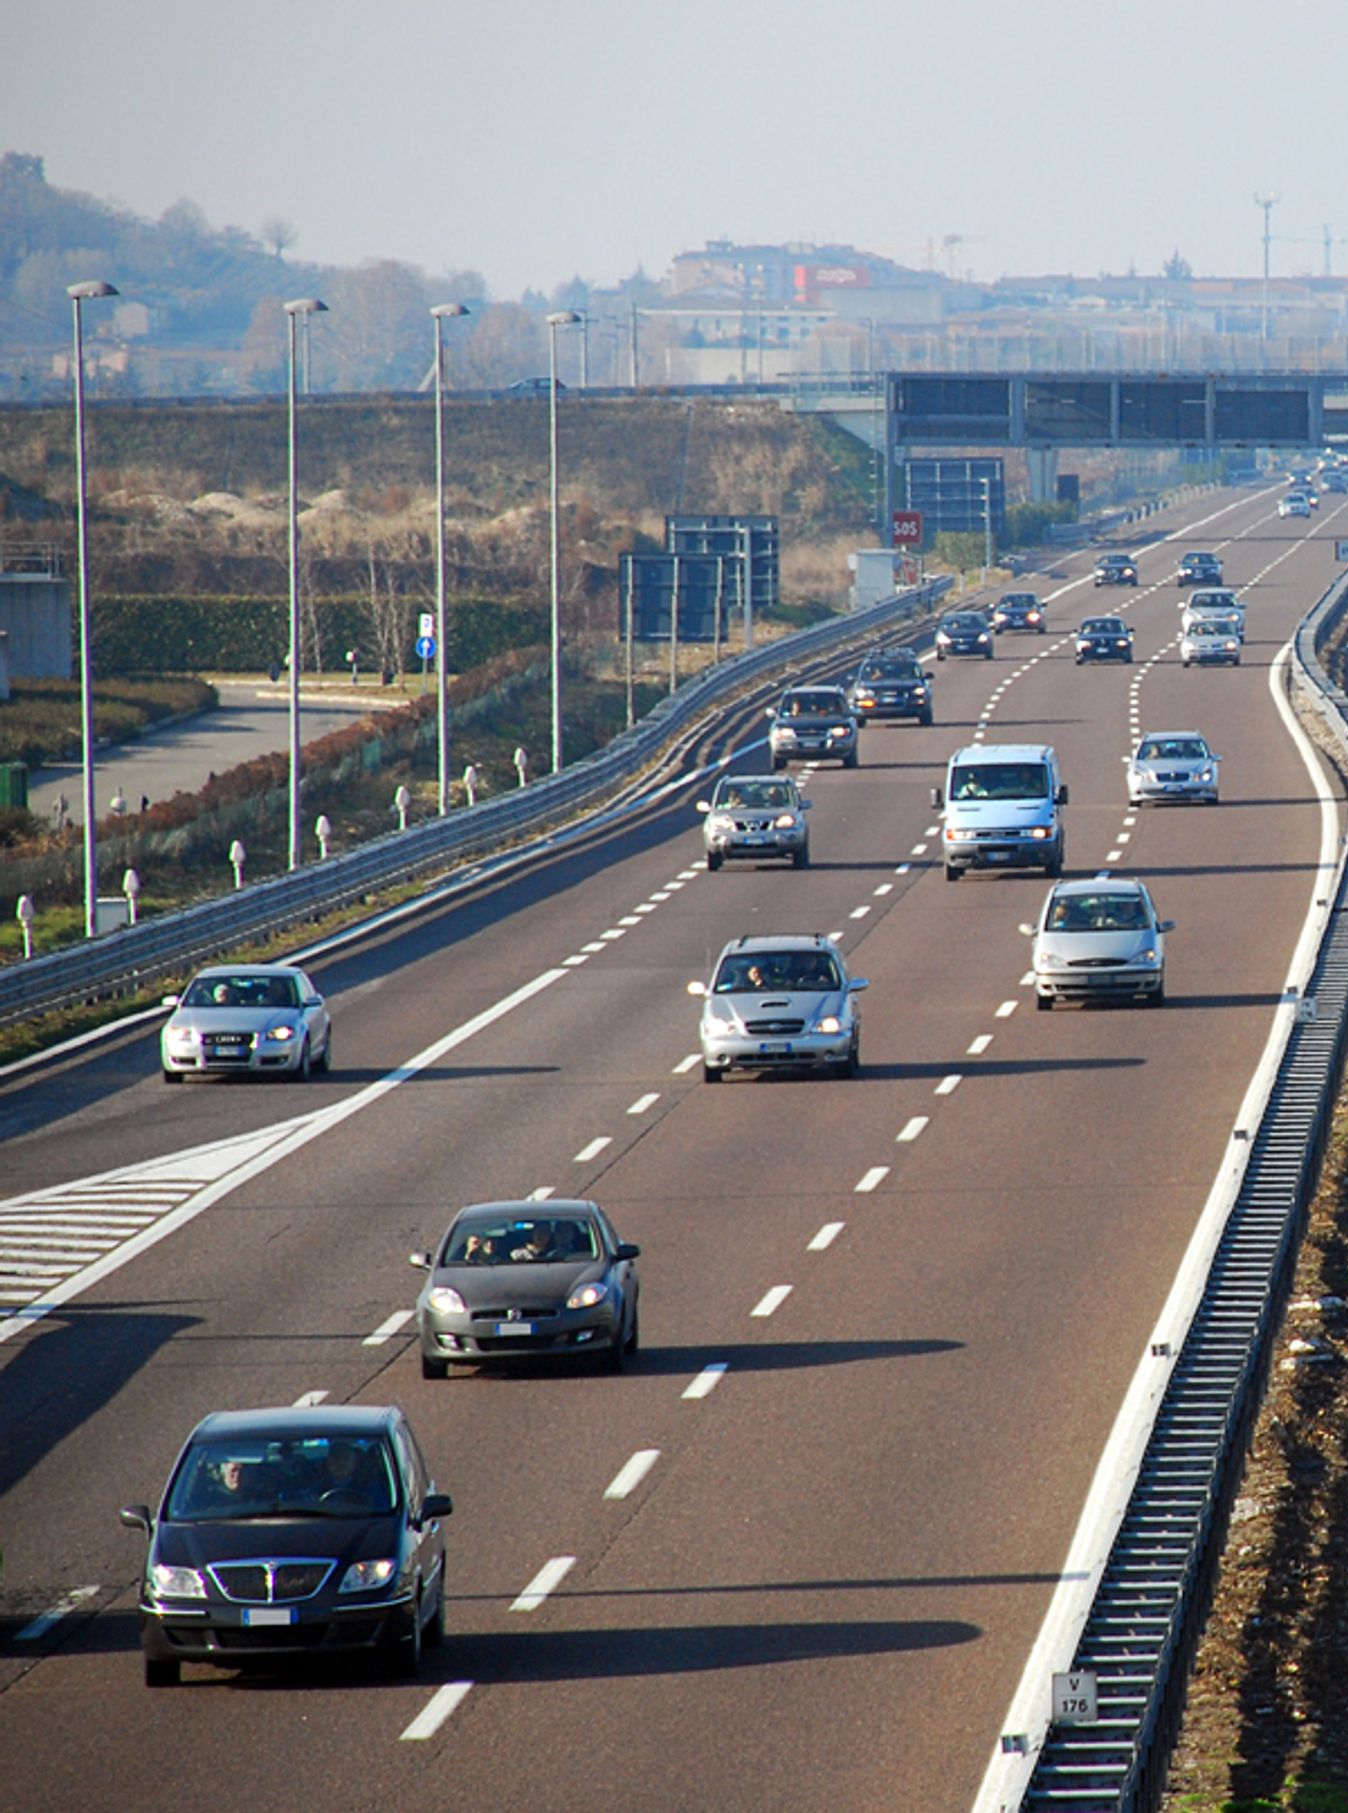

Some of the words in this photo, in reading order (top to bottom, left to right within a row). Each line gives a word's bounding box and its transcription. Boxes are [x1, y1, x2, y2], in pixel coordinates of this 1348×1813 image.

[894, 520, 918, 537] SOS
[1069, 1677, 1080, 1691] V
[1062, 1698, 1088, 1713] 176
